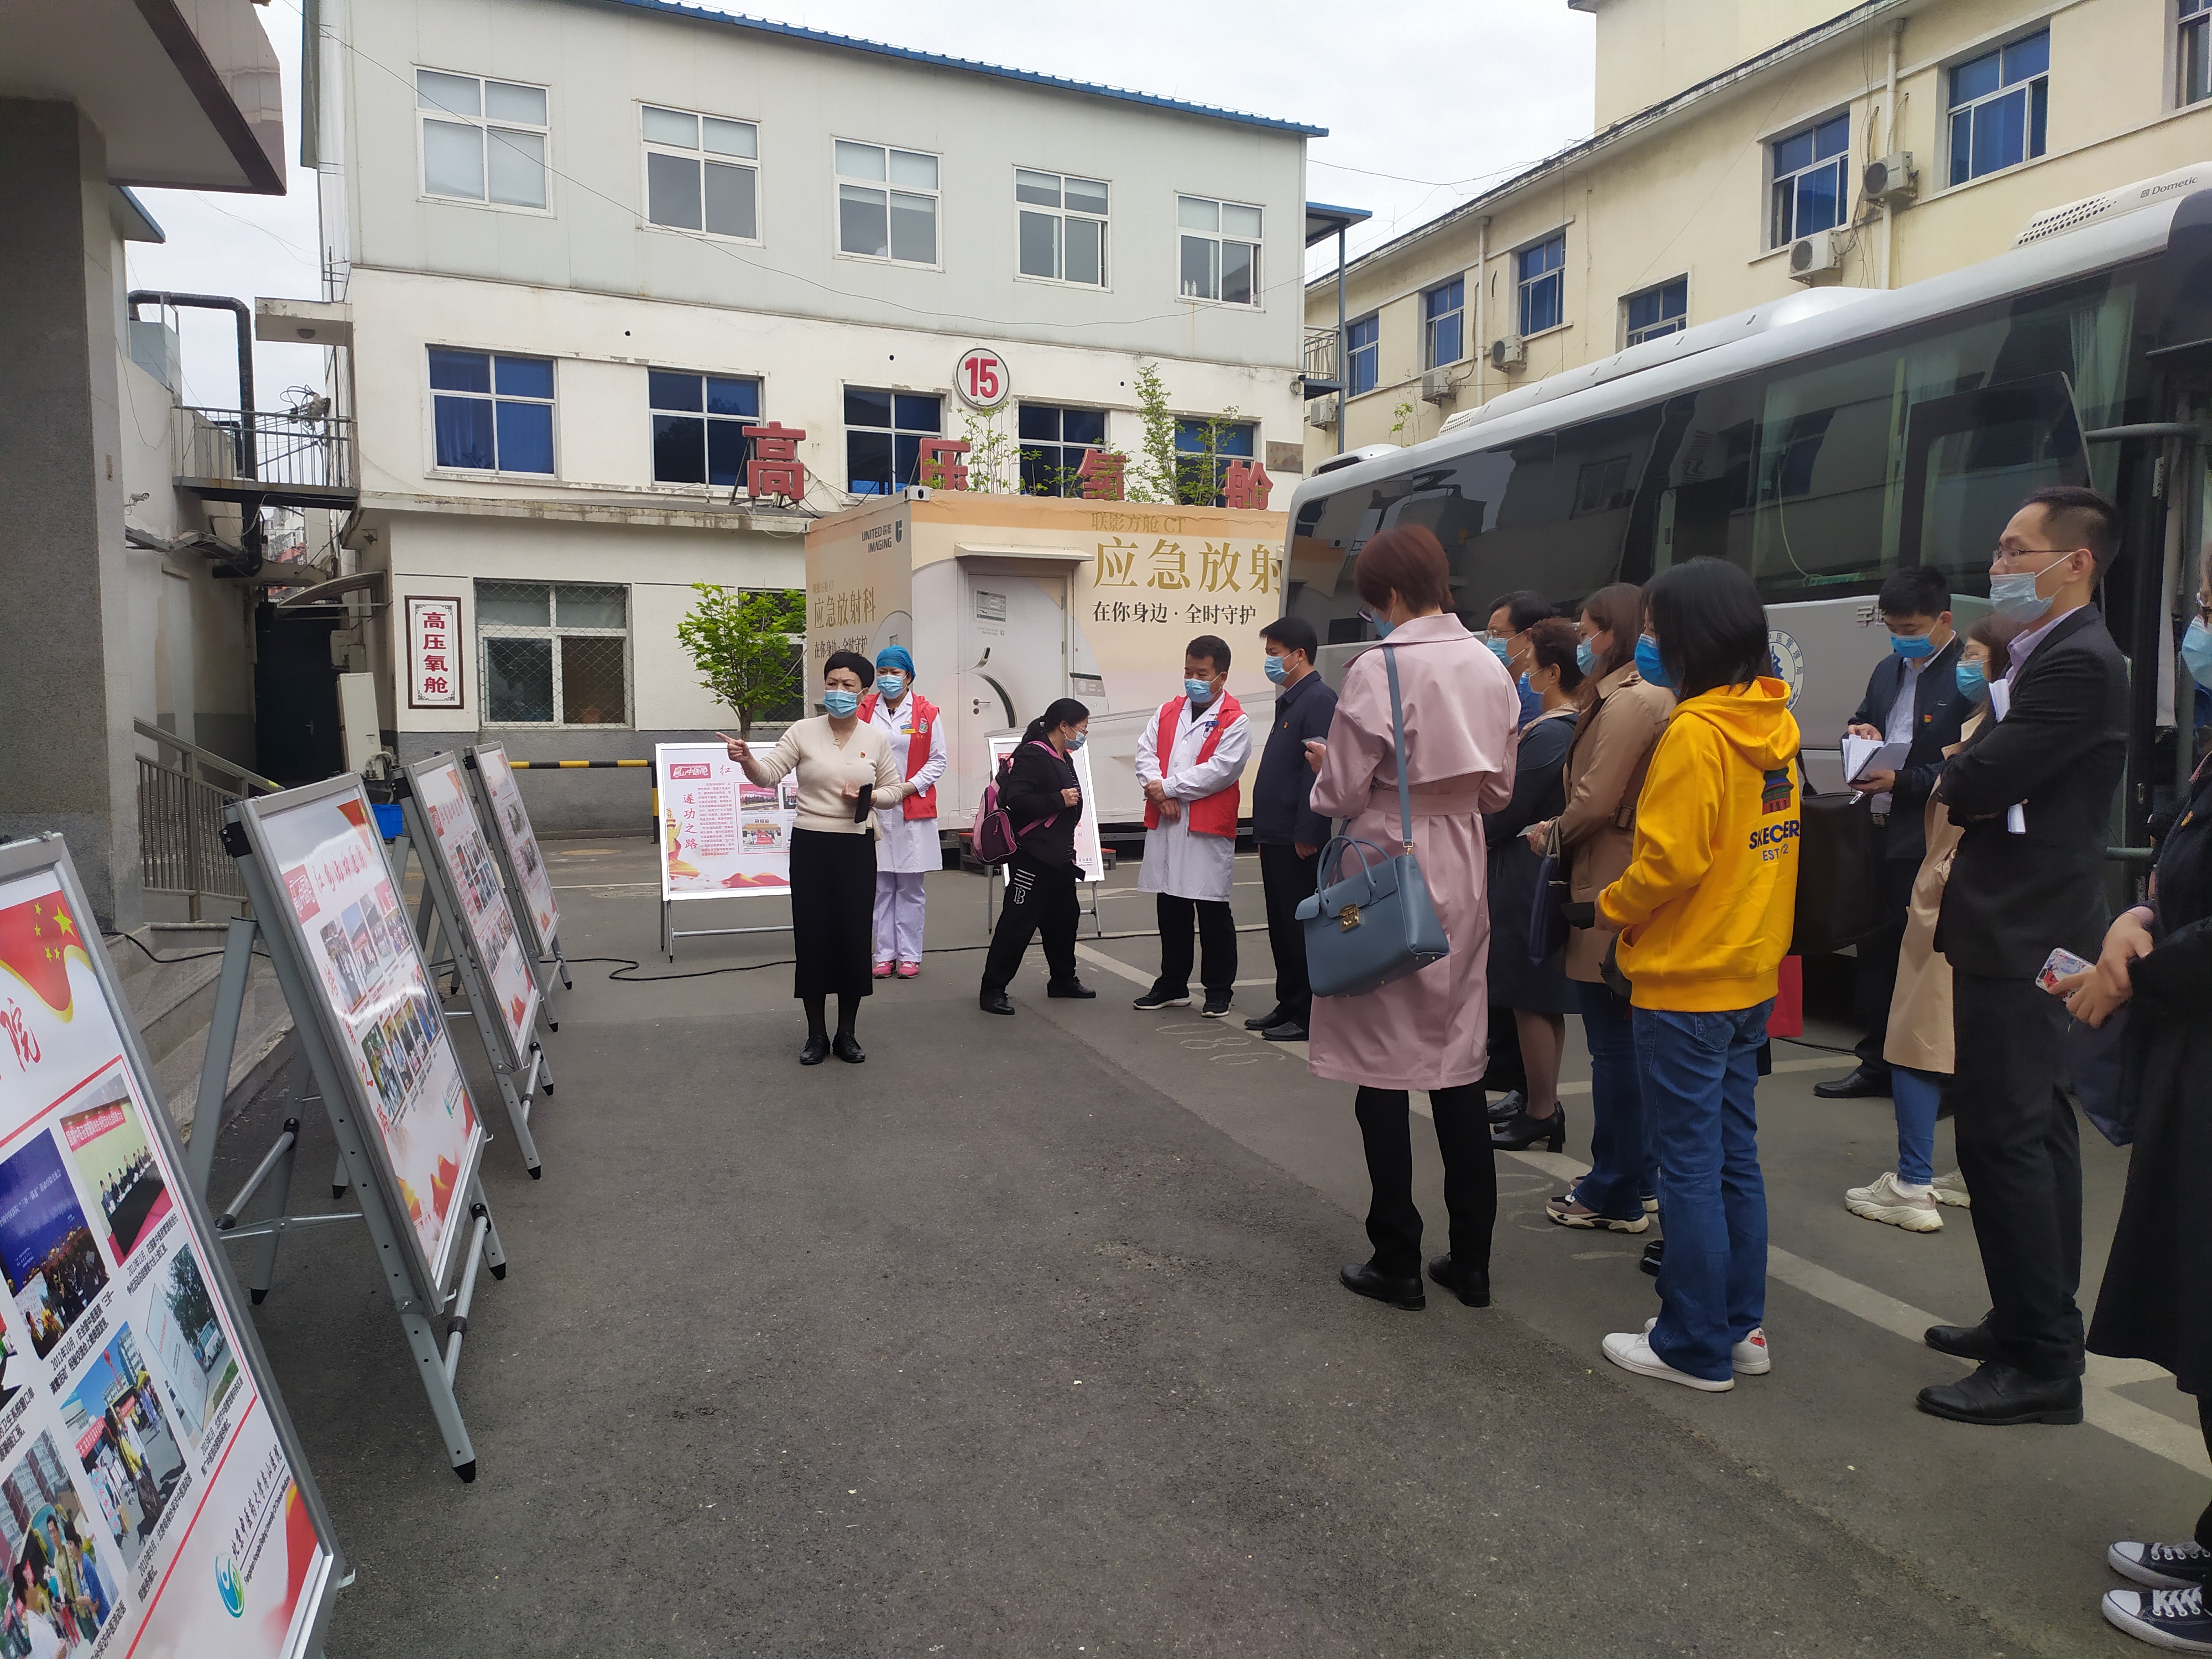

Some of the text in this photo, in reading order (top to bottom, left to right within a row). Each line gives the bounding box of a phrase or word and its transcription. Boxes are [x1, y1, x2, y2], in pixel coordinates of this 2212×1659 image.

[2151, 176, 2199, 195] Dometic
[964, 356, 999, 399] 15
[862, 526, 882, 542] UNITED
[868, 537, 893, 553] IMAGING
[815, 586, 876, 630] 应急放射科
[422, 612, 448, 693] 高压氧舱
